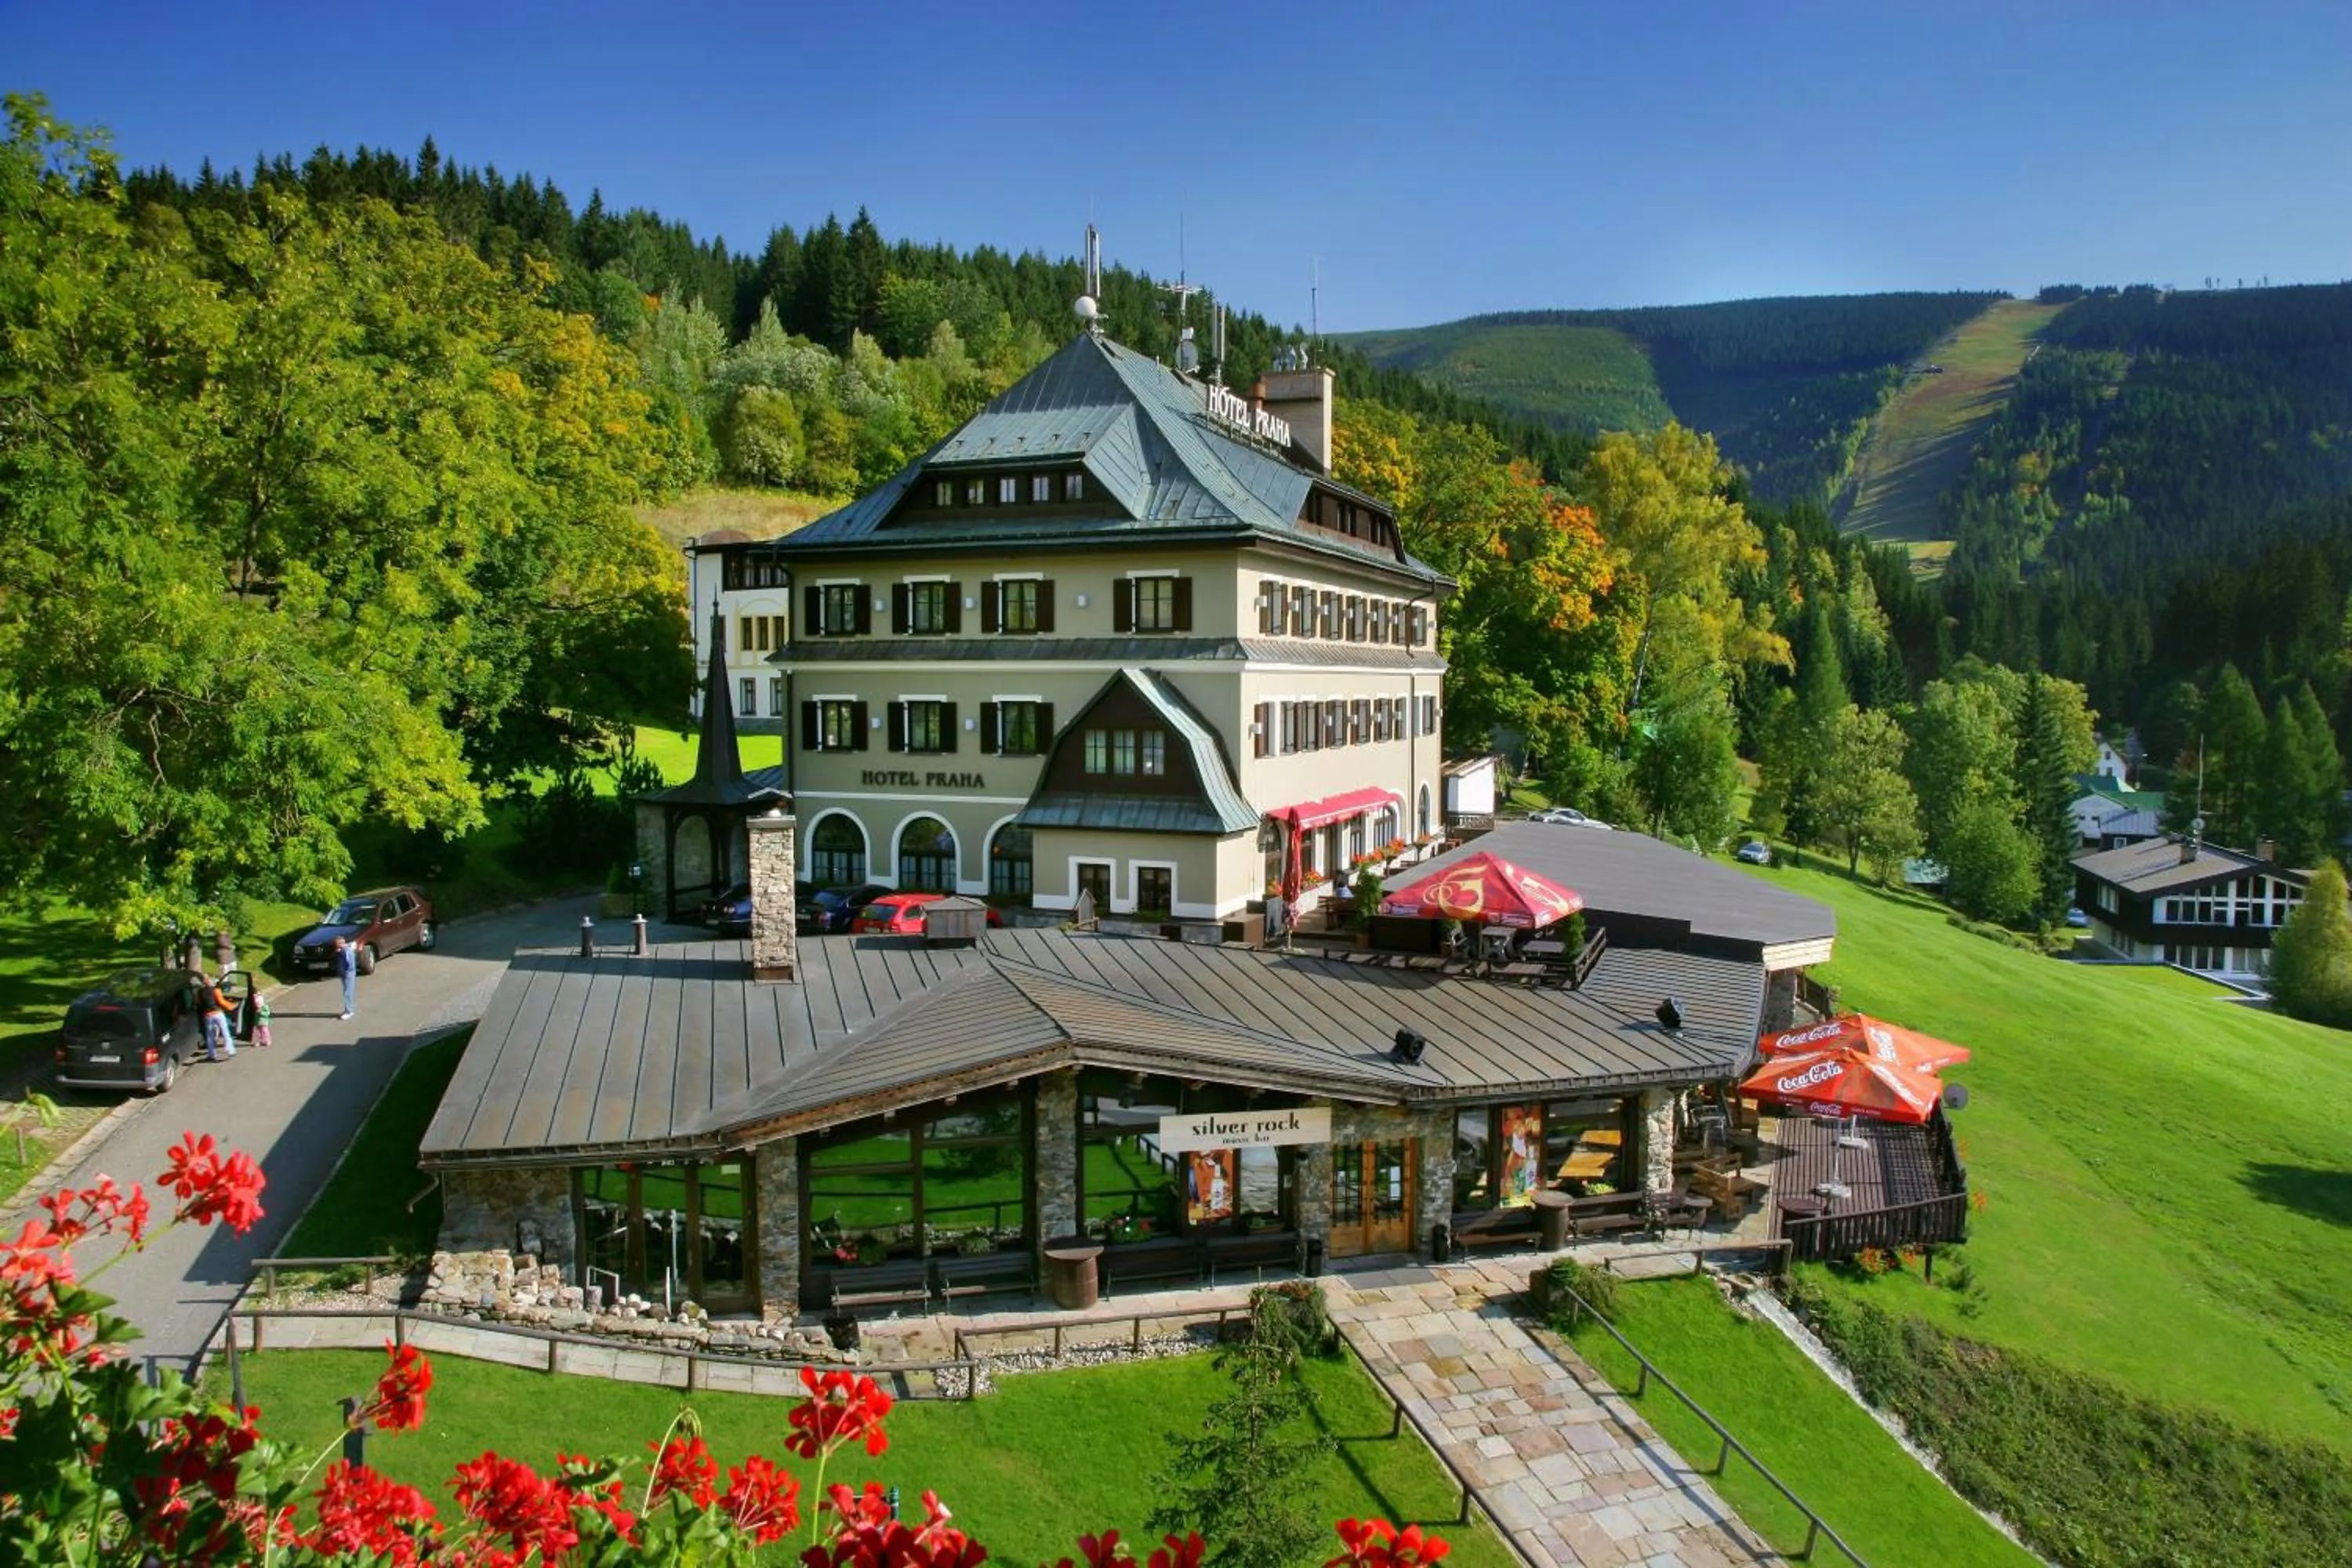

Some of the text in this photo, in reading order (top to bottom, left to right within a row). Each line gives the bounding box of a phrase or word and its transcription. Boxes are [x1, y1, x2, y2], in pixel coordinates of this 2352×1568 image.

[1208, 384, 1291, 448] HOTEL PRAHA
[862, 770, 985, 789] HOTEL PRAHA
[1192, 1112, 1300, 1136] silver rock
